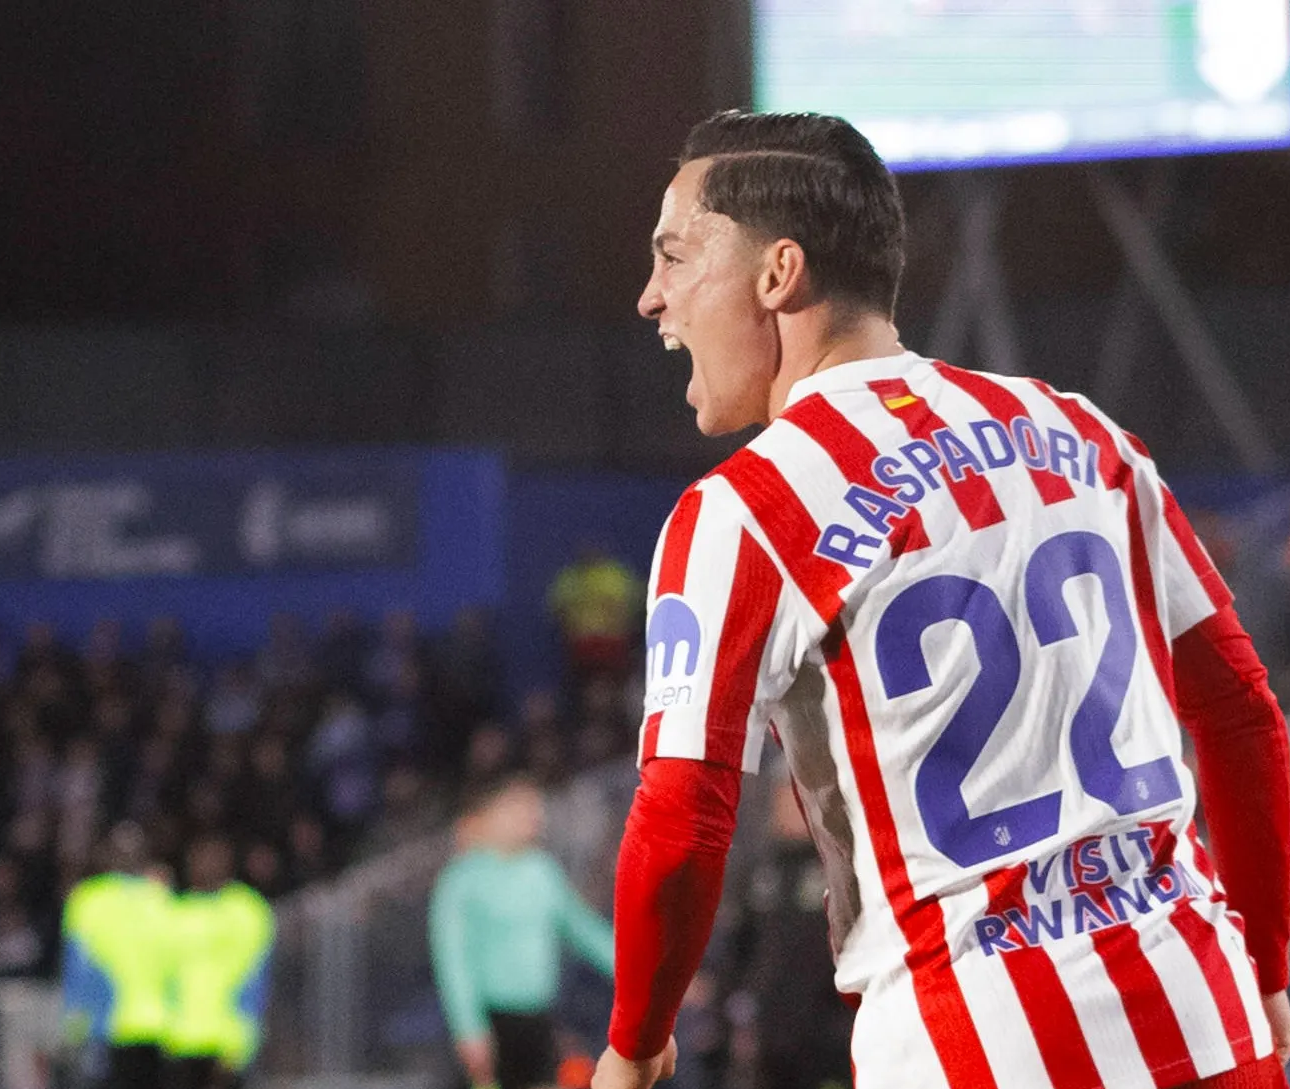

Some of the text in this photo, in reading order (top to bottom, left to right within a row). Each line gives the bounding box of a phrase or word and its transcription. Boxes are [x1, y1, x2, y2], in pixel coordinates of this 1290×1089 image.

[816, 419, 1097, 567] RASPADORI
[876, 531, 1181, 867] 22
[975, 860, 1204, 957] RWANDA
[1028, 829, 1154, 894] VISIT
